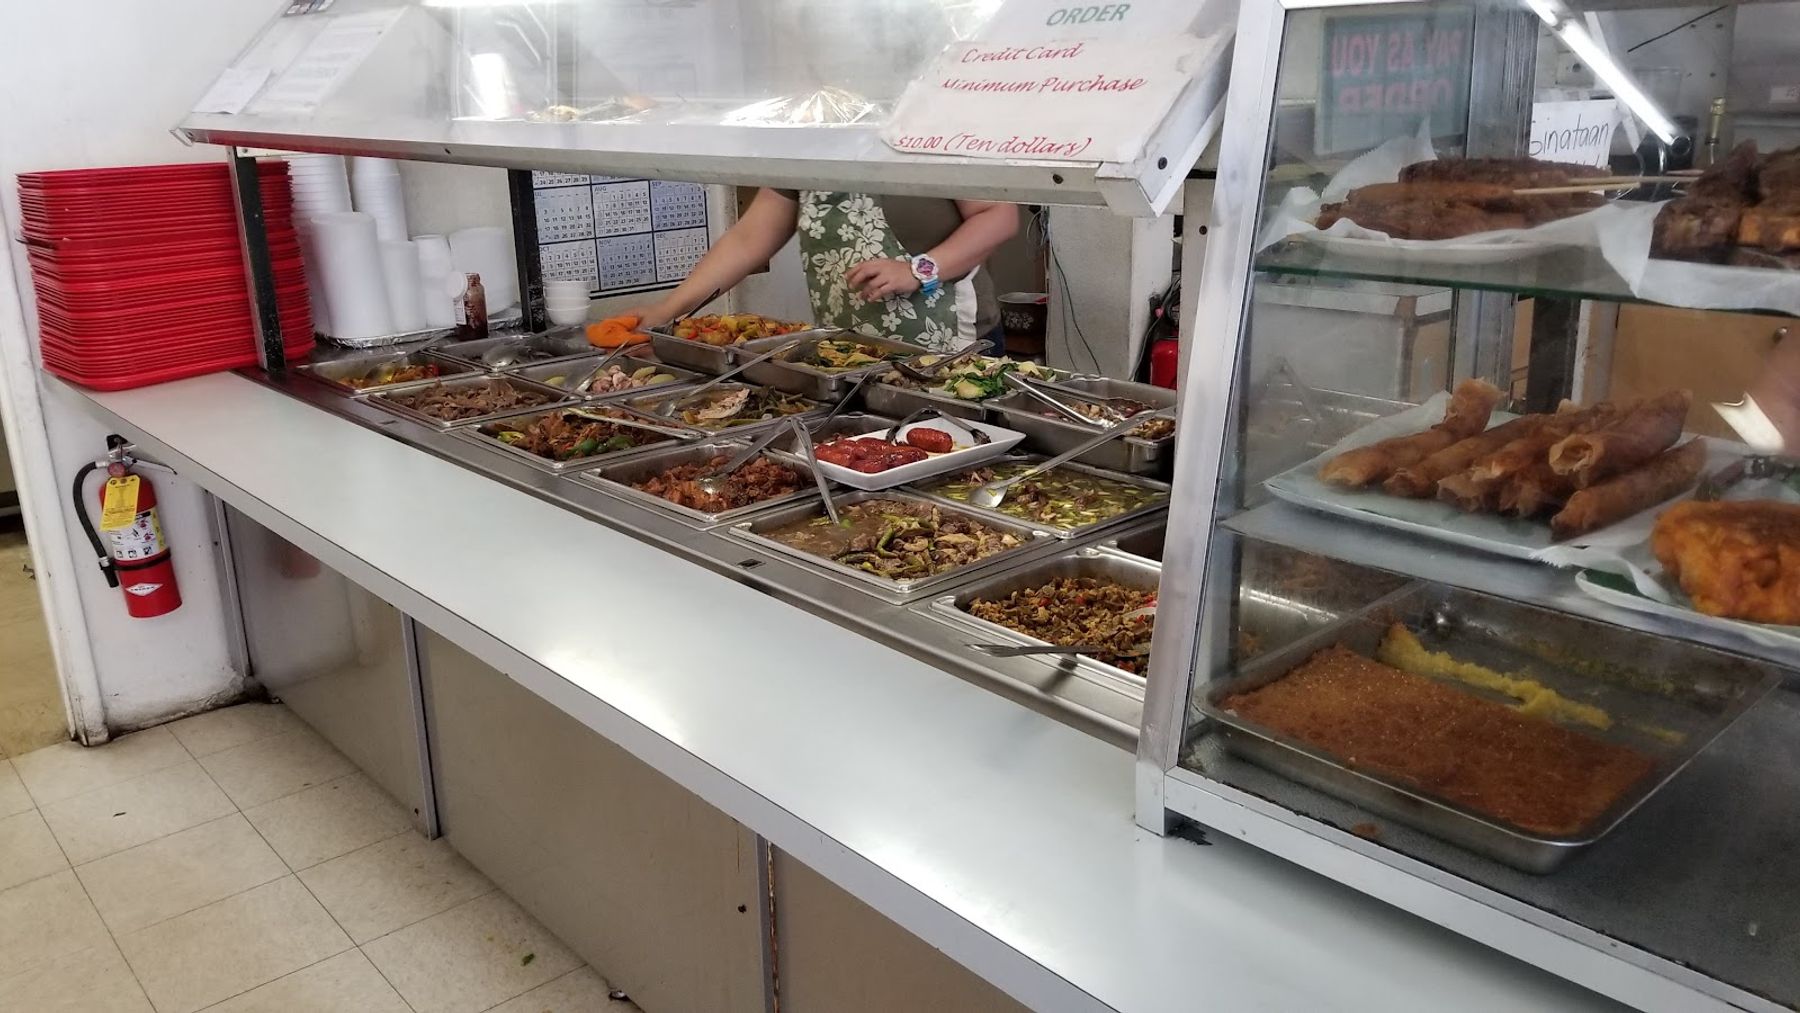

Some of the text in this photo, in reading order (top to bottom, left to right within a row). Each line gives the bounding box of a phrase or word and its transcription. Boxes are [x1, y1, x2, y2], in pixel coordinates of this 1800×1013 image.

[1046, 4, 1131, 26] ORDER
[961, 41, 1086, 63] Credit Card
[1038, 74, 1148, 94] Purchase
[893, 132, 1093, 157] $10.00 (Ten dollars)
